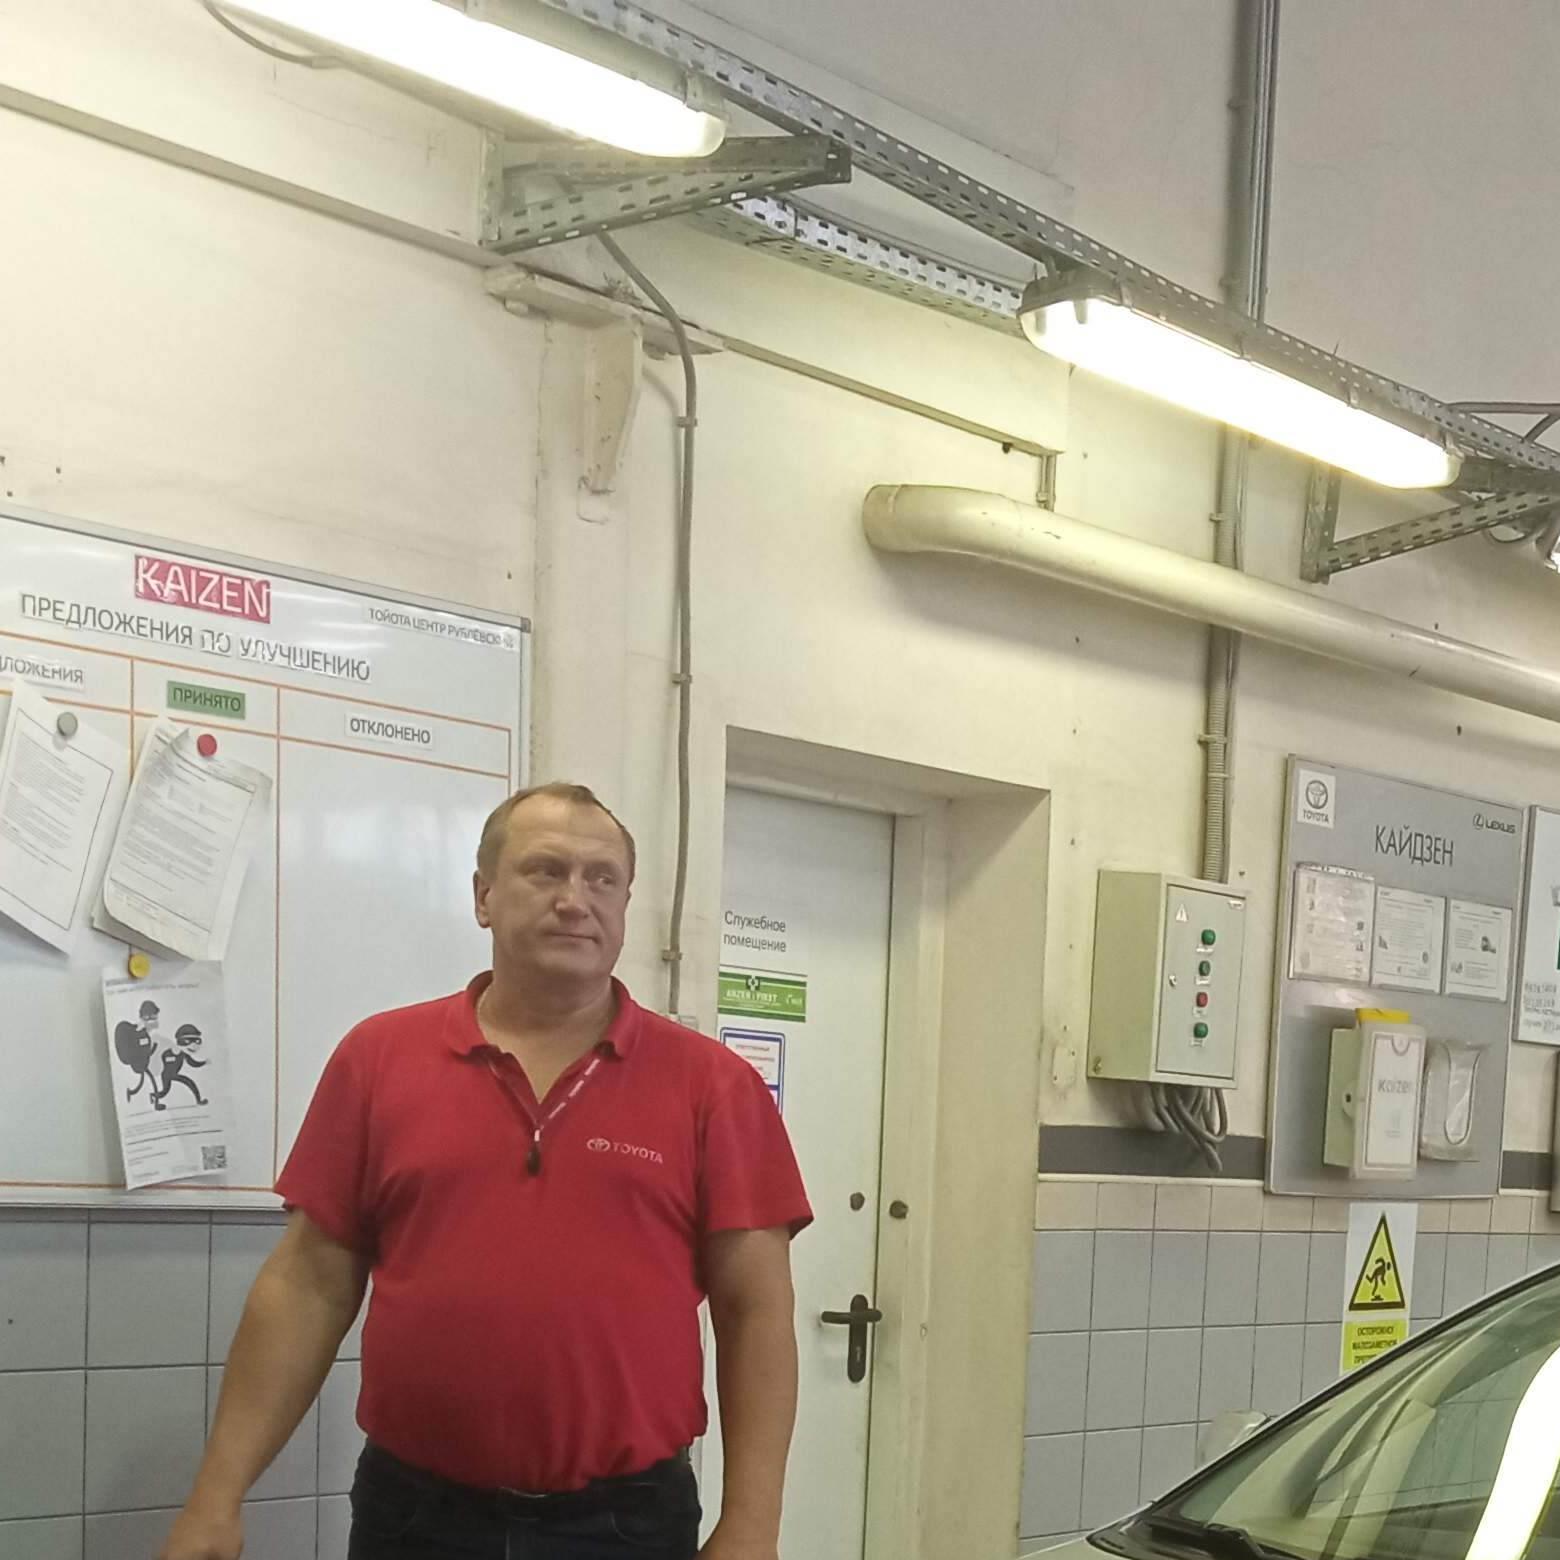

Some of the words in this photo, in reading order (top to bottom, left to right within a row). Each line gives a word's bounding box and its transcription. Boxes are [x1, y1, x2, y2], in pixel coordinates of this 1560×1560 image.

[137, 557, 269, 619] KAIZEN
[369, 608, 411, 628] ТОЙОТА
[413, 618, 446, 633] ЦЕНТР
[21, 594, 193, 646] ПРЕДЛОЖЕНИЯ
[202, 629, 231, 654] ПО
[240, 637, 371, 681] УЛУЧШЕНИЮ
[173, 688, 241, 712] ПРИНЯТО
[350, 718, 431, 744] ОТКЛОНЕНО
[1303, 809, 1329, 823] TOYOTA
[1375, 824, 1453, 867] КАЙДЗЕН
[724, 910, 786, 932] Служебное
[723, 933, 787, 952] помещение
[613, 1142, 664, 1165] TOYOTA
